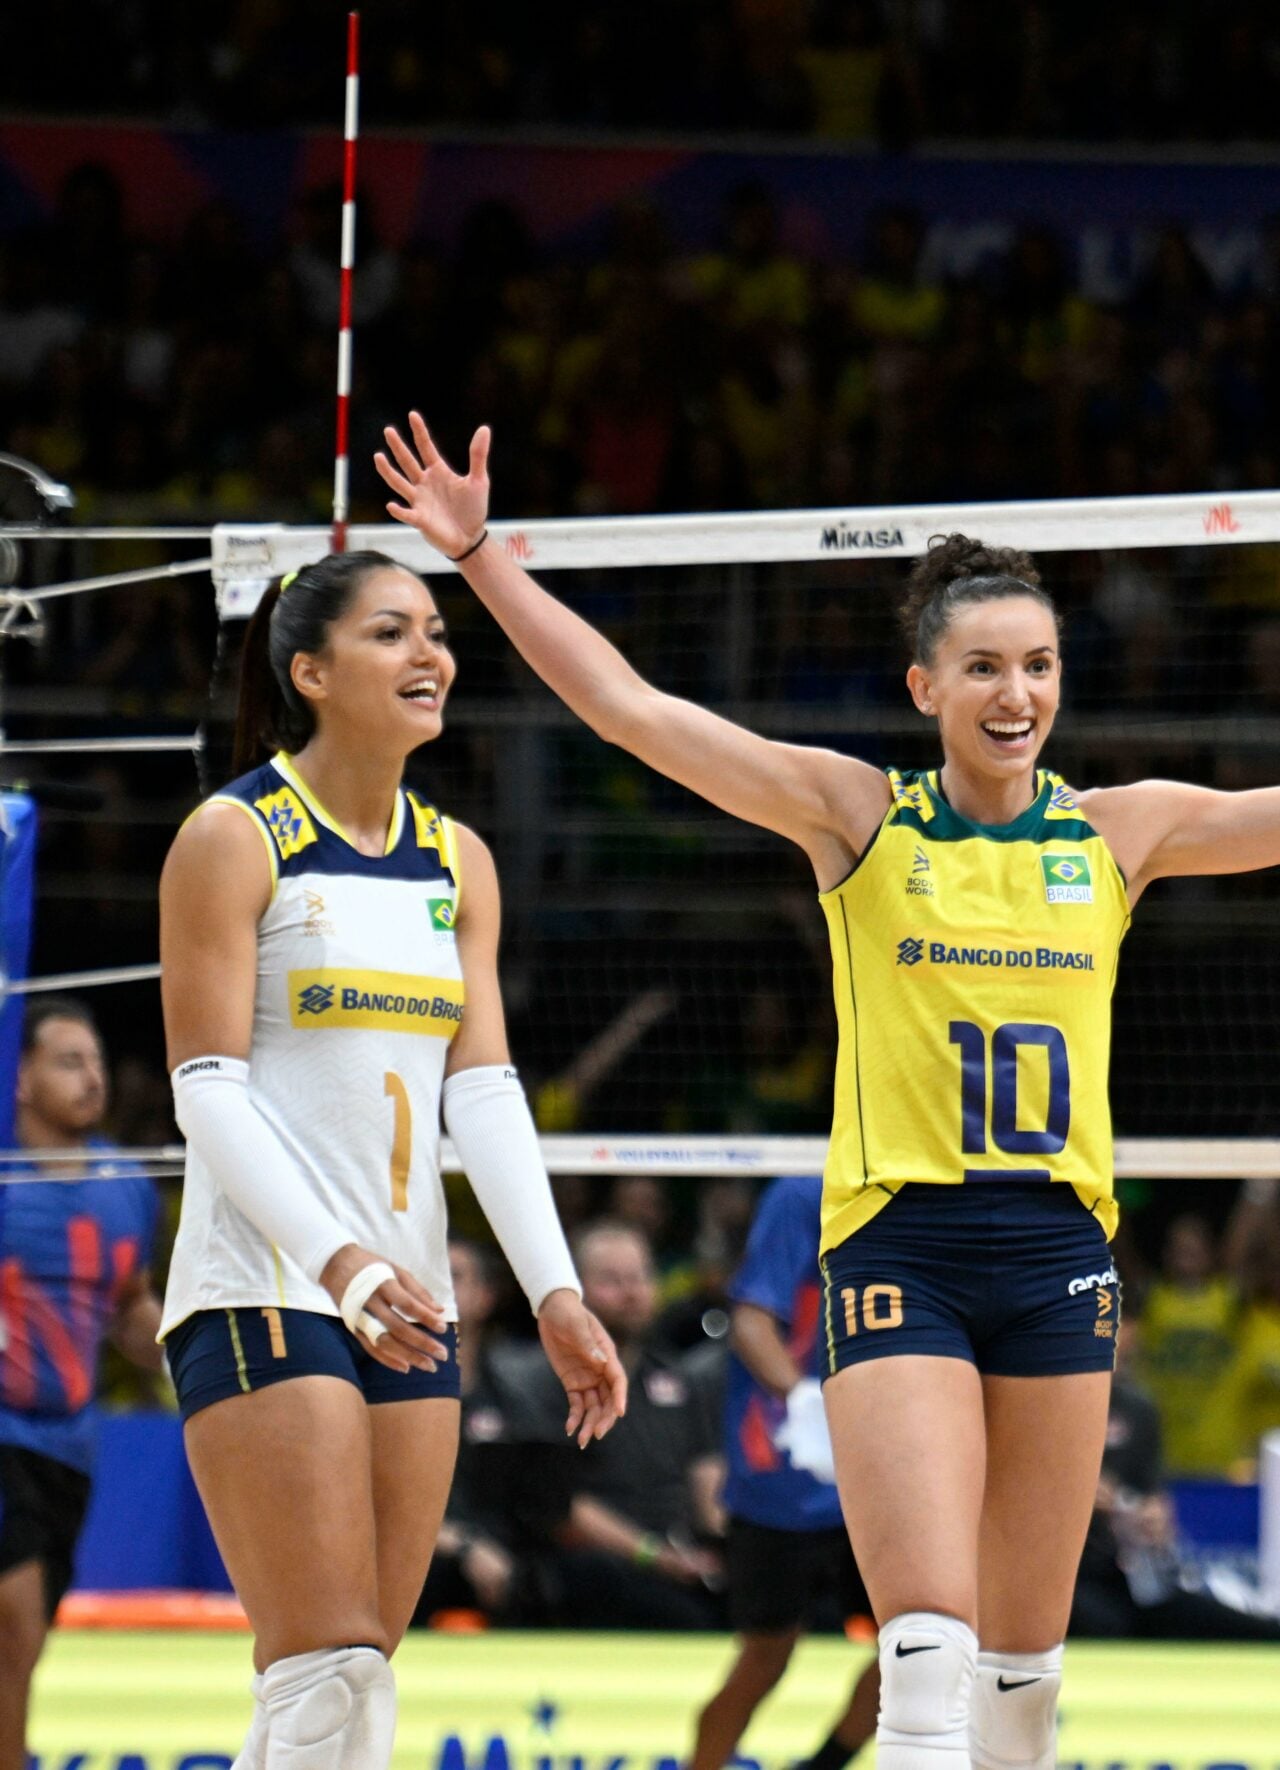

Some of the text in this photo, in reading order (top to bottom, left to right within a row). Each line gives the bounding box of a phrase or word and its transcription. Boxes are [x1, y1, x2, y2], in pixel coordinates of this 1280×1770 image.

[1046, 887, 1093, 901] BRASIL
[929, 942, 1095, 971] BANCO DO BRASIL
[341, 988, 404, 1014] BANCO
[407, 997, 429, 1017] DO
[949, 1021, 1071, 1155] 10
[384, 1071, 412, 1212] 1
[261, 1307, 287, 1358] 1
[841, 1284, 903, 1336] 10
